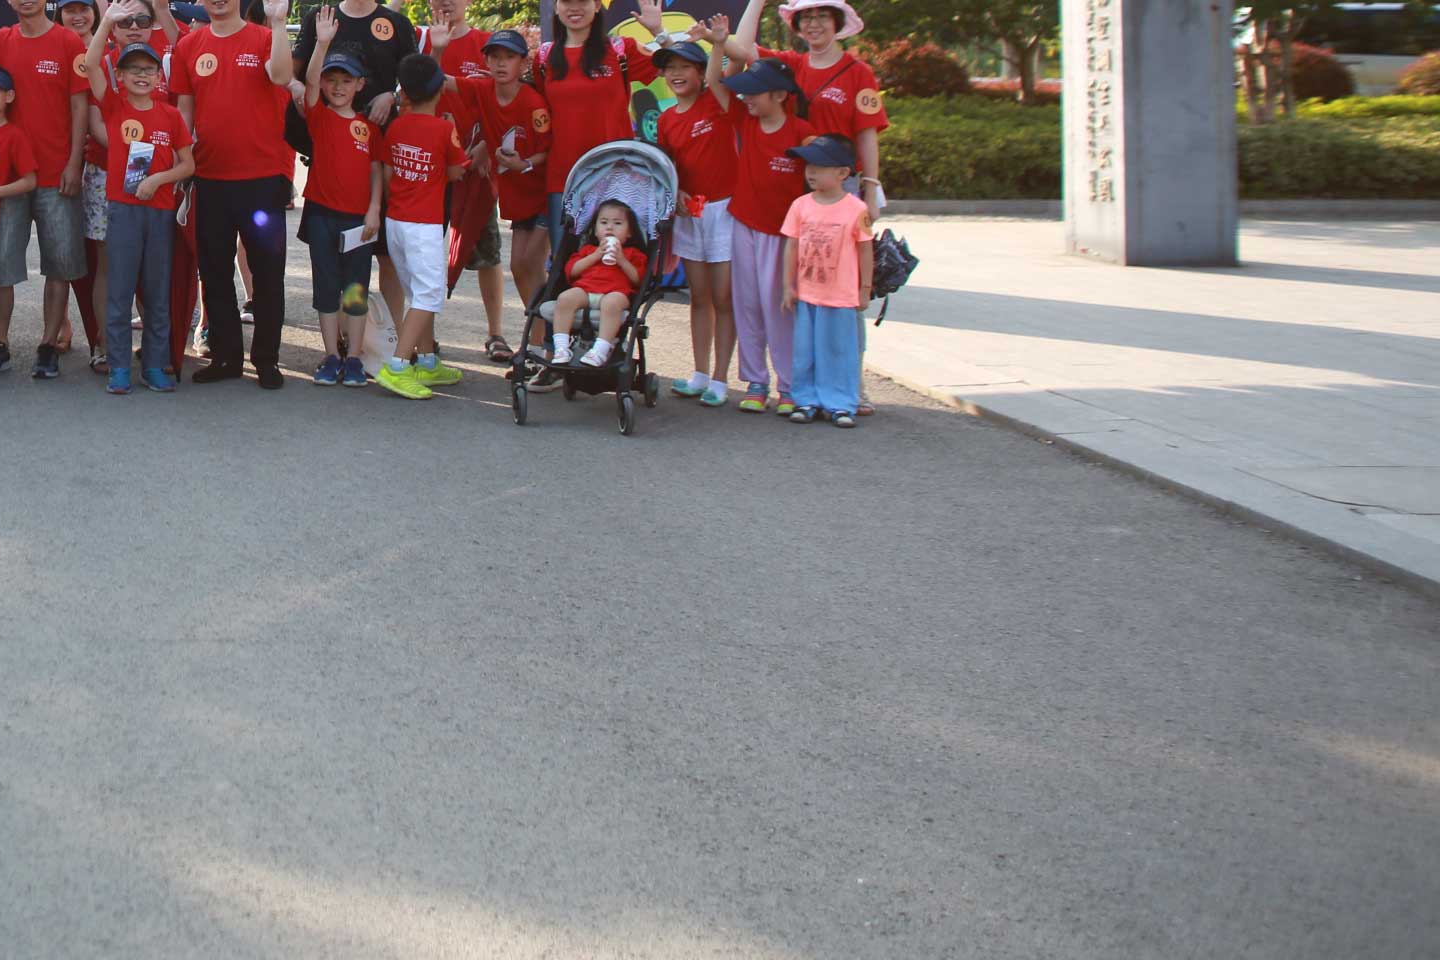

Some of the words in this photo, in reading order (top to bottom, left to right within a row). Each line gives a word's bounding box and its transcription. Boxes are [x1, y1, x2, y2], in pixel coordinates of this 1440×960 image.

[375, 23, 389, 35] 03
[199, 59, 213, 70] 10
[861, 95, 878, 108] 09
[124, 126, 139, 139] 10
[354, 126, 368, 137] 03
